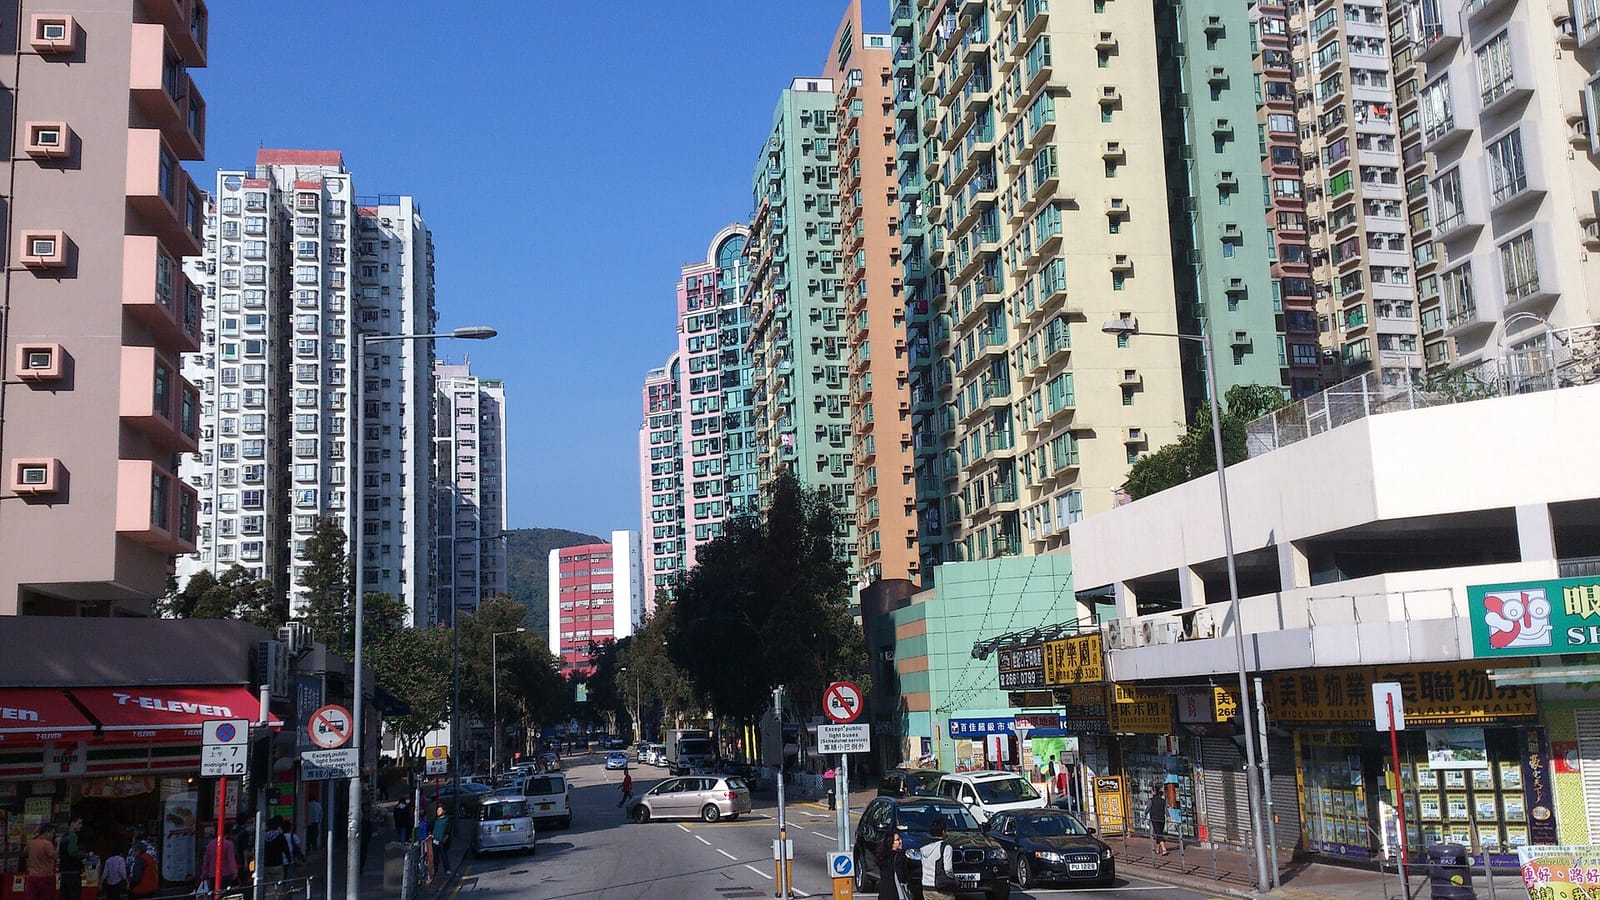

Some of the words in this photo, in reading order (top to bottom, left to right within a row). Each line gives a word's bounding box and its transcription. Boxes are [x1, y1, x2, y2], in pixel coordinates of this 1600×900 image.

[1471, 703, 1532, 713] REALTY
[230, 746, 238, 757] 7
[230, 762, 244, 773] 12
